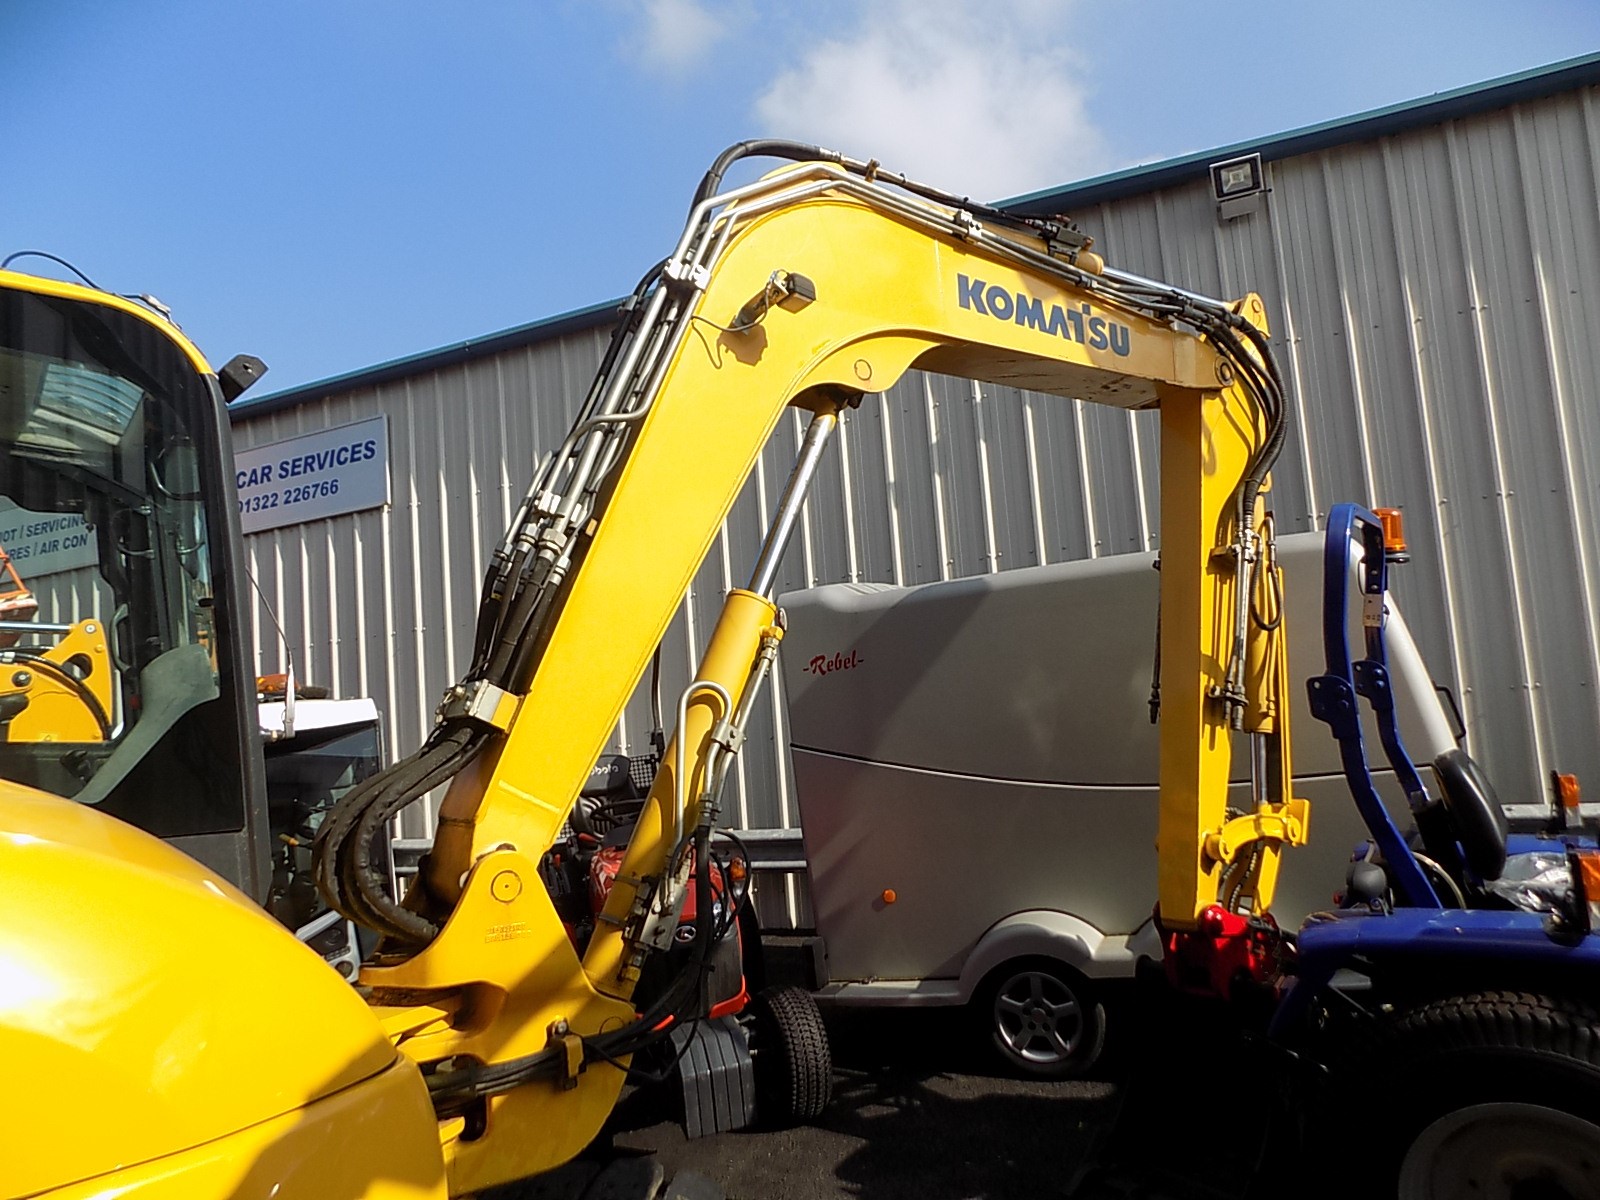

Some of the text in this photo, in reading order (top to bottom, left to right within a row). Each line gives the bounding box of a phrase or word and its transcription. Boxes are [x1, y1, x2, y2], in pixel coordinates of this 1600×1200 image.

[957, 273, 1131, 357] KOMATSU
[236, 440, 376, 489] CAR SERVICES
[283, 479, 339, 505] 226766
[39, 539, 60, 555] AIR
[62, 533, 88, 550] CON
